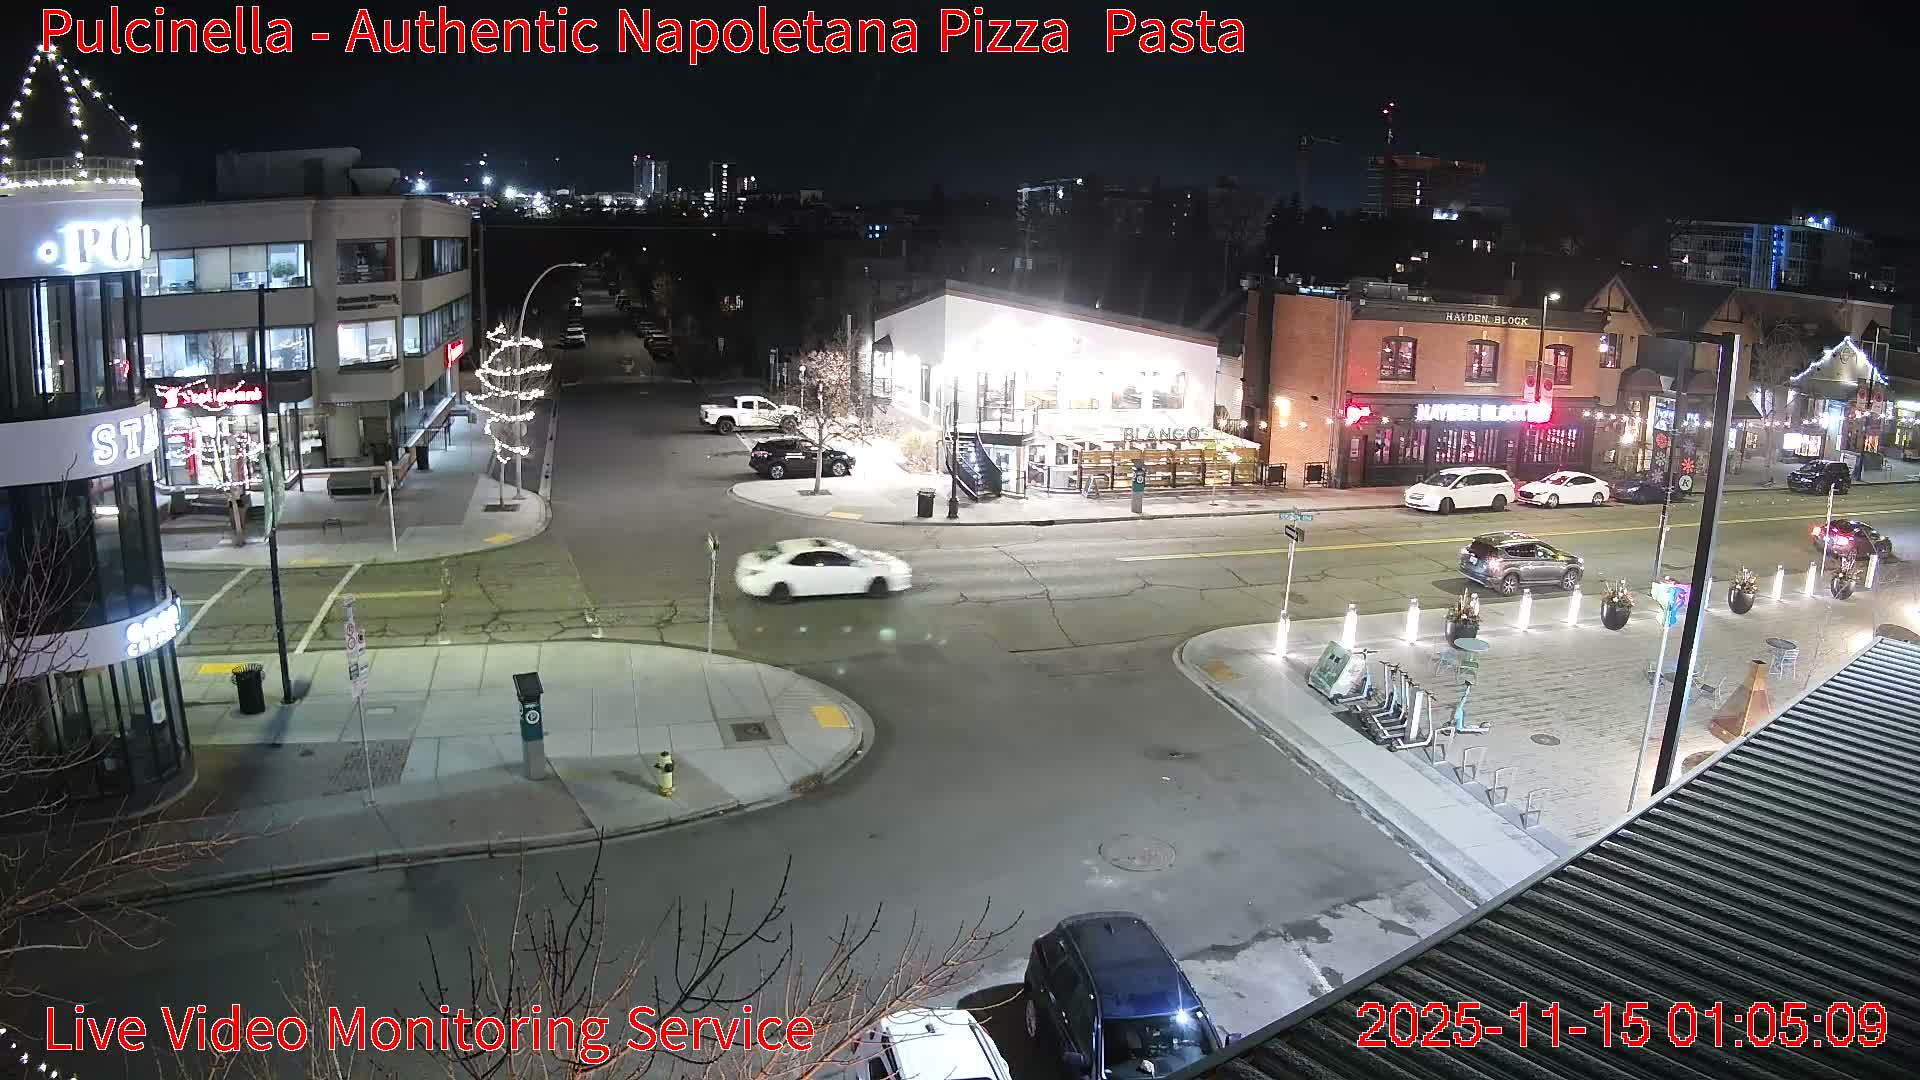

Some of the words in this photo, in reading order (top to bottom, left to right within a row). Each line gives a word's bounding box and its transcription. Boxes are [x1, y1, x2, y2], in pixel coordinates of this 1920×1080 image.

[1445, 312, 1488, 324] HAYDEN
[1494, 316, 1528, 326] BLOCK
[1123, 426, 1200, 441] BLANCO
